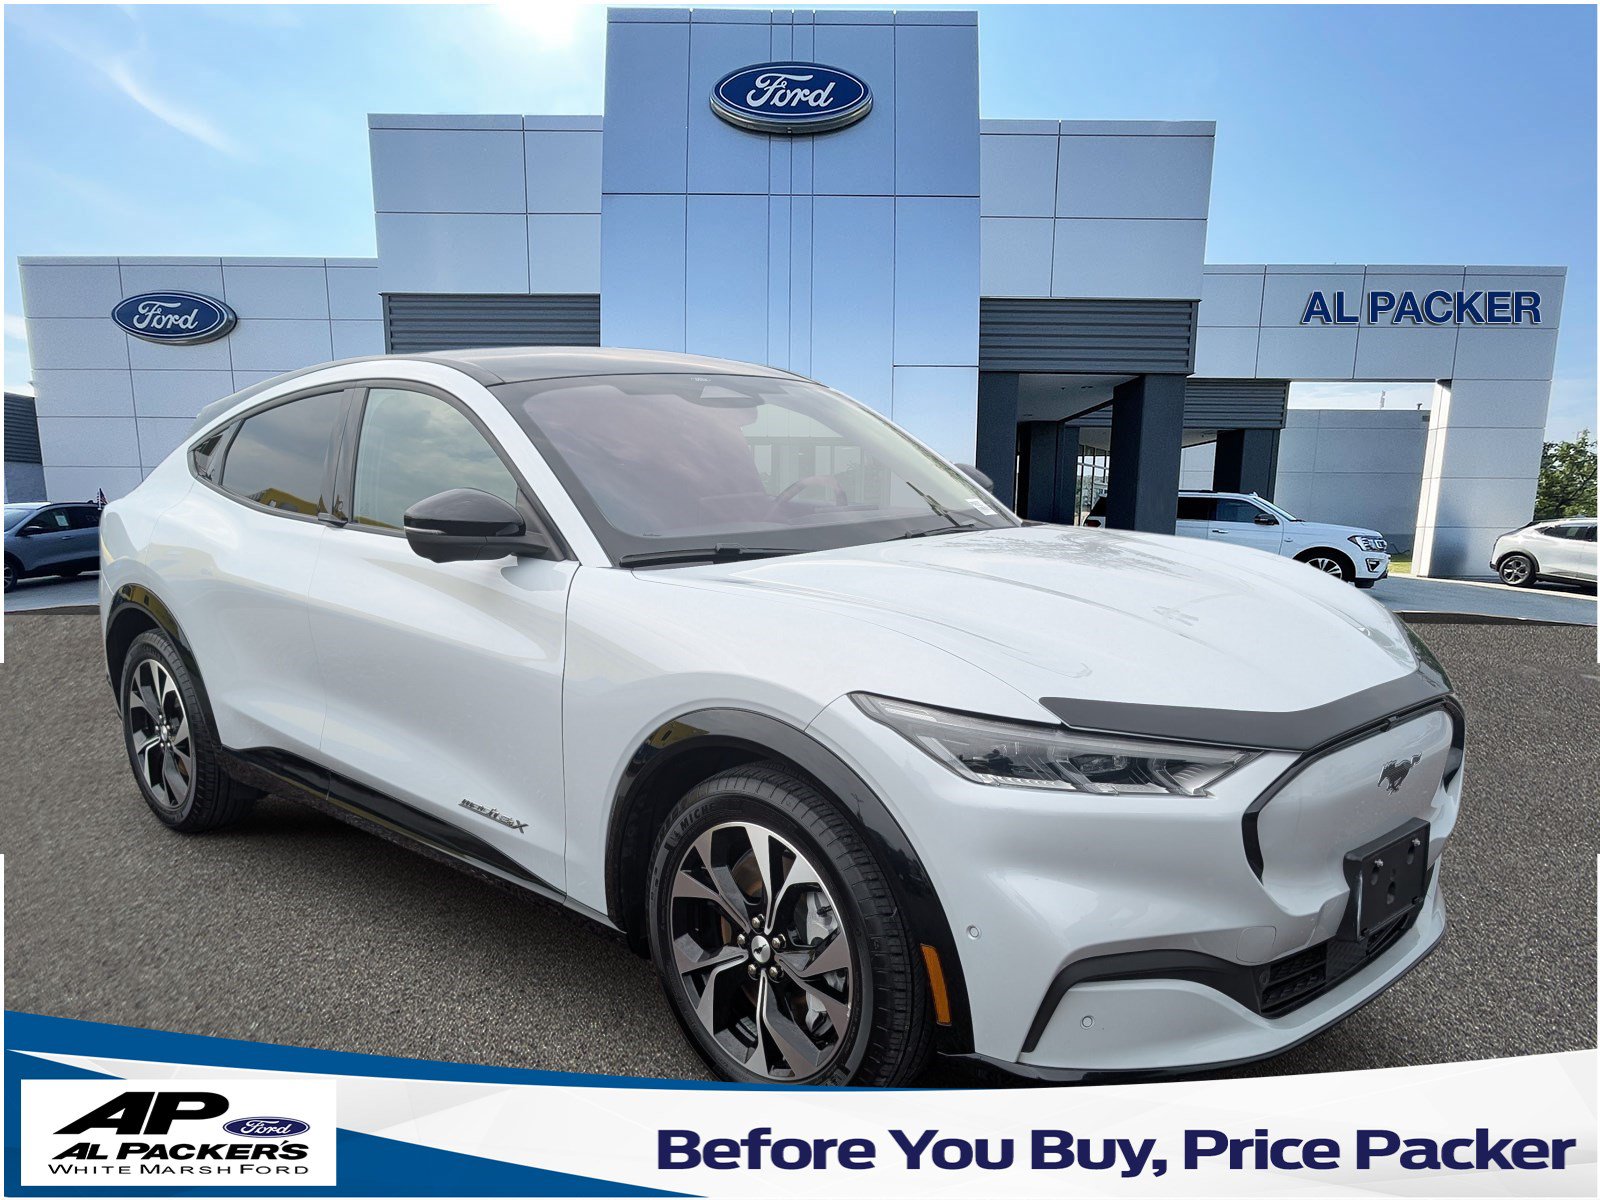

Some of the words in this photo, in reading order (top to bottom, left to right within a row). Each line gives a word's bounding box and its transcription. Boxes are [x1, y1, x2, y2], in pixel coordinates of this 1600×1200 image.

[746, 73, 836, 108] Ford
[133, 301, 199, 329] Ford
[1302, 290, 1360, 324] AL
[1369, 290, 1542, 324] PACKER
